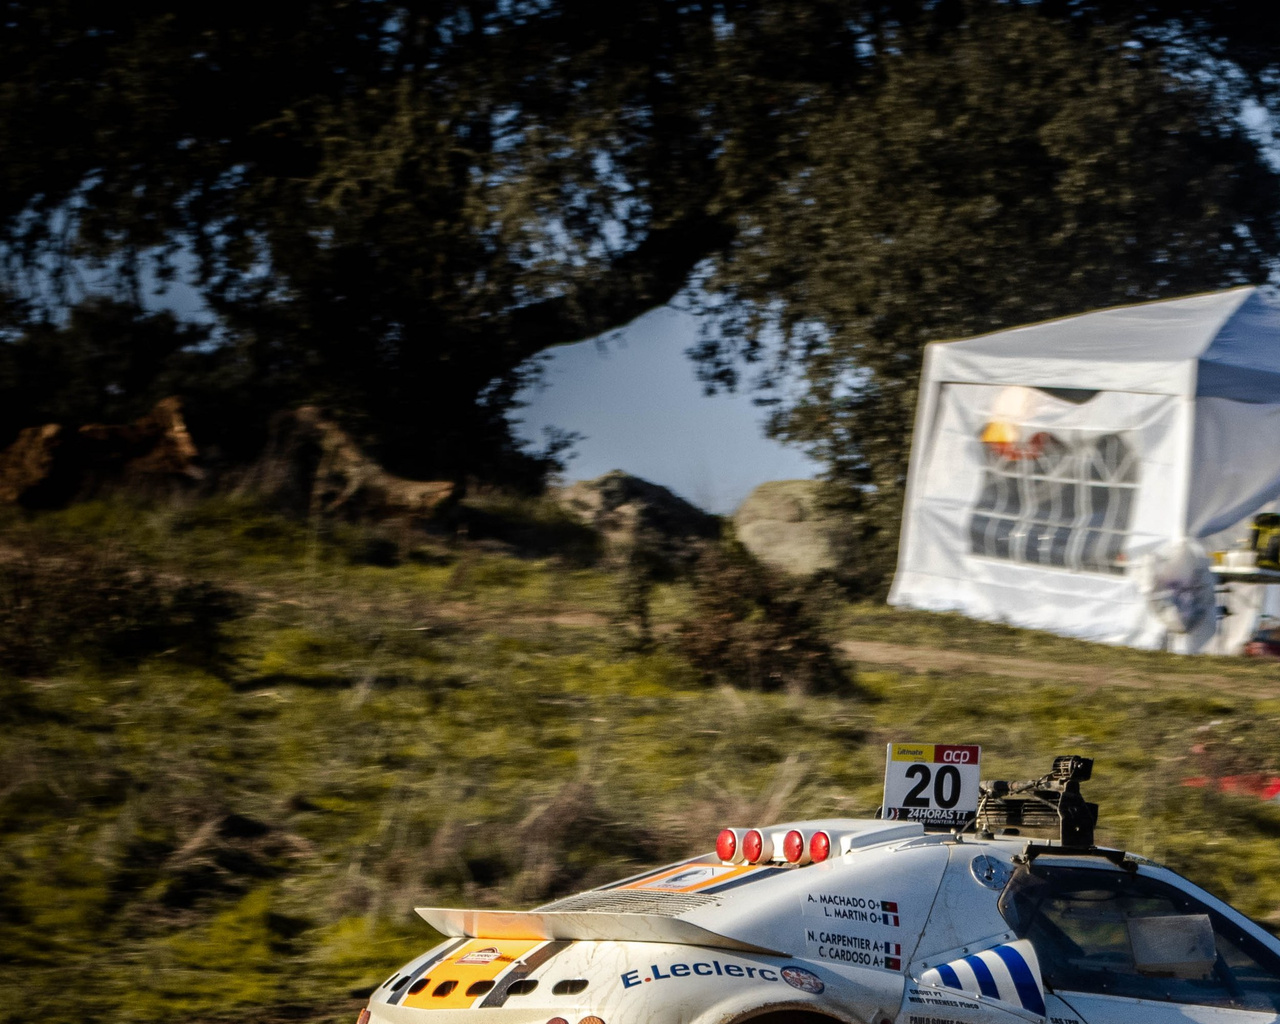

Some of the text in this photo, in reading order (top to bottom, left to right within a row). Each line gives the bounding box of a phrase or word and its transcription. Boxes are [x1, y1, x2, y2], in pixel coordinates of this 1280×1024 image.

[943, 750, 970, 765] acp
[902, 764, 961, 809] 20
[907, 808, 968, 820] 24HORAS TT
[807, 893, 880, 910] A. MACHADO O+
[824, 907, 882, 923] L. MARTIN O+
[807, 930, 884, 952] N. CARPENTIER A+
[819, 946, 884, 967] C. CARDOSO A+
[620, 960, 779, 989] E.Leclerc
[926, 998, 958, 1008] PYRENEES
